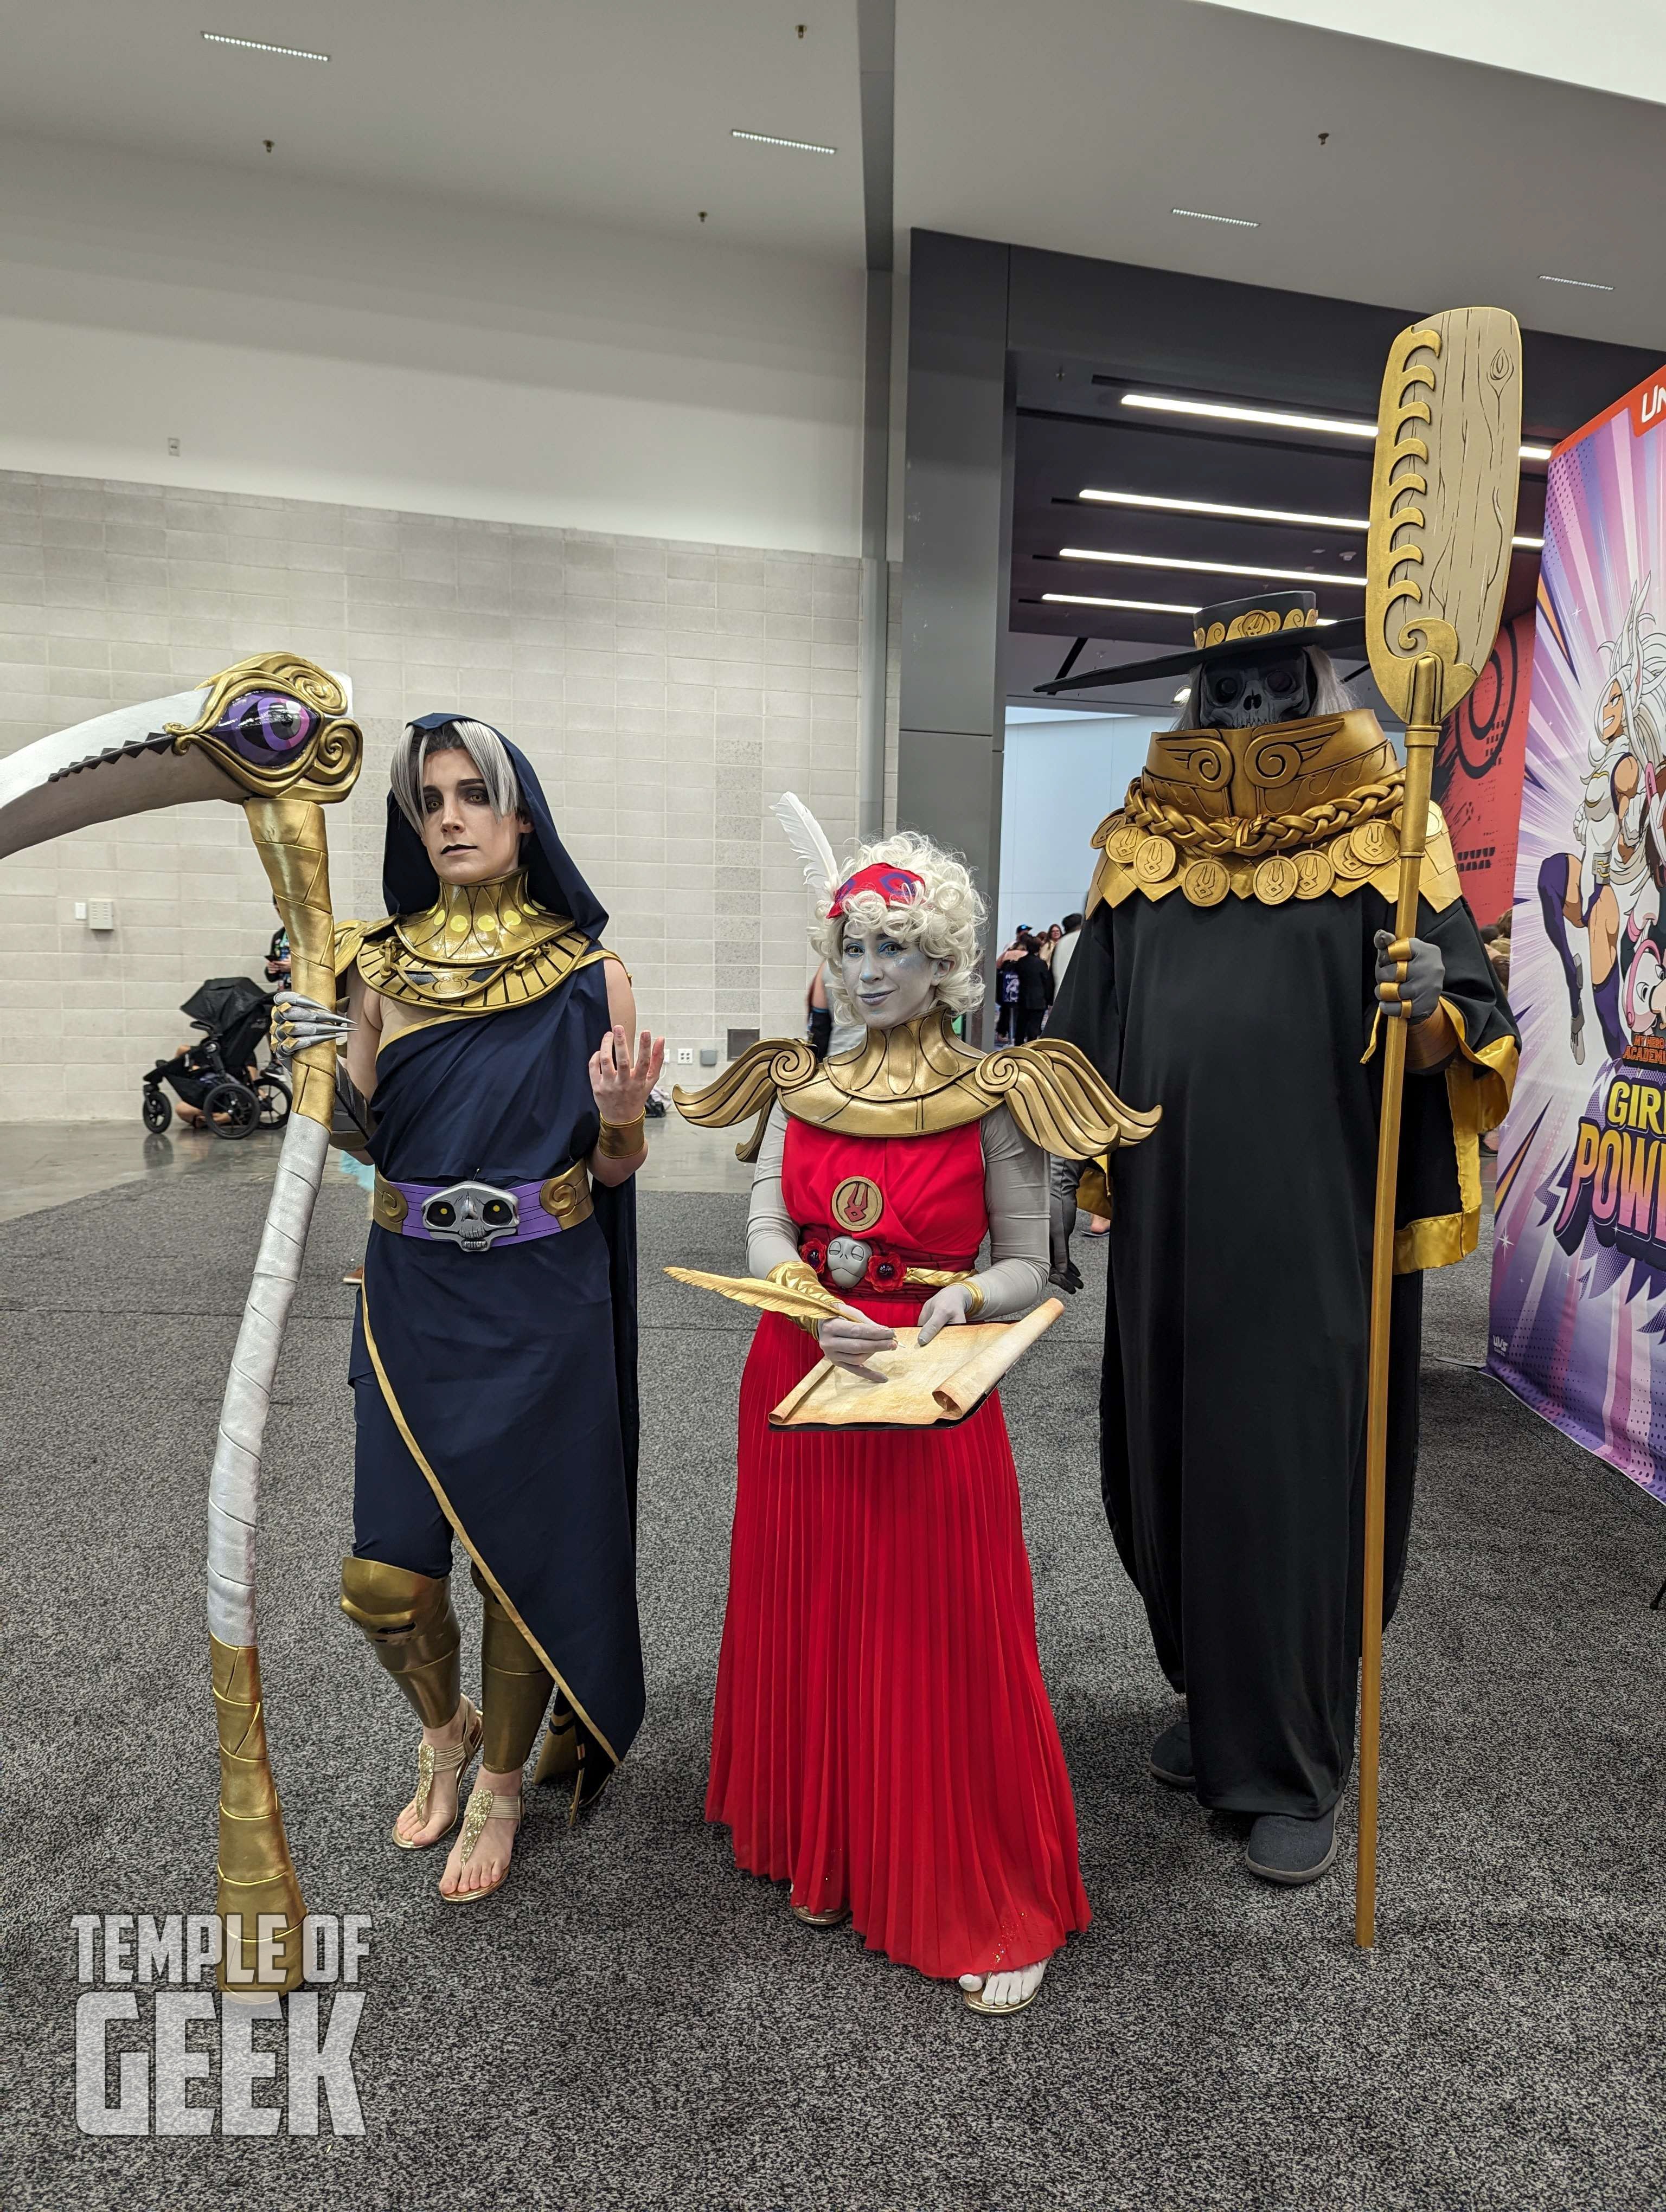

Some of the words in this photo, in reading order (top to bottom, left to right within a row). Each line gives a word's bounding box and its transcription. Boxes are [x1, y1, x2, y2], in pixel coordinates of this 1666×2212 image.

[1646, 1037, 1665, 1049] HERO
[1607, 1081, 1666, 1135] GIR
[1493, 1335, 1508, 1352] UVS
